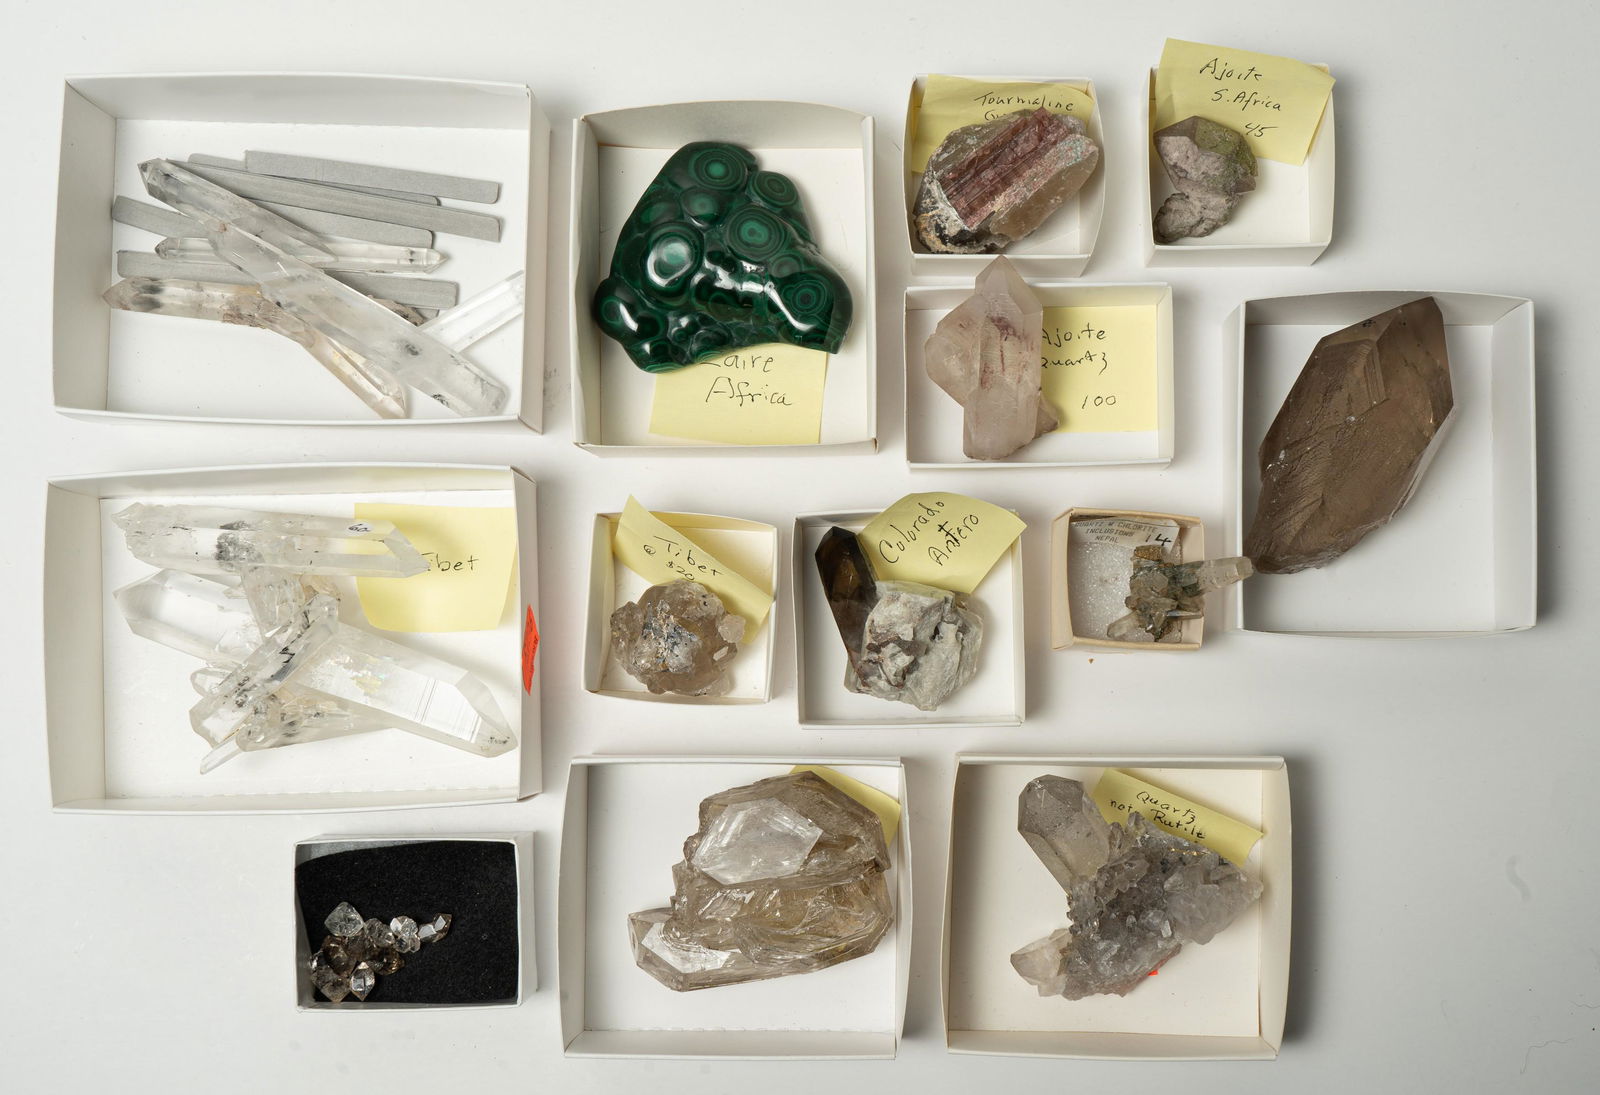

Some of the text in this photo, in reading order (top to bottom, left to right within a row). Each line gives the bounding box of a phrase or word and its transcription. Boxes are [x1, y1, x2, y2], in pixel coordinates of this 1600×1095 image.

[1200, 57, 1263, 81] Ajoite
[974, 91, 1074, 112] Tourmaline
[1245, 122, 1279, 138] 45
[705, 376, 792, 407] Africa
[1082, 395, 1117, 410] 100
[879, 501, 945, 564] Colorado
[1085, 528, 1135, 538] INCLUSIONS
[1095, 535, 1120, 543] NEPAL
[1145, 533, 1172, 546] 14
[653, 535, 725, 577] Tibet
[666, 561, 695, 581] $20
[1110, 799, 1133, 813] not
[1136, 791, 1196, 825] Quartz
